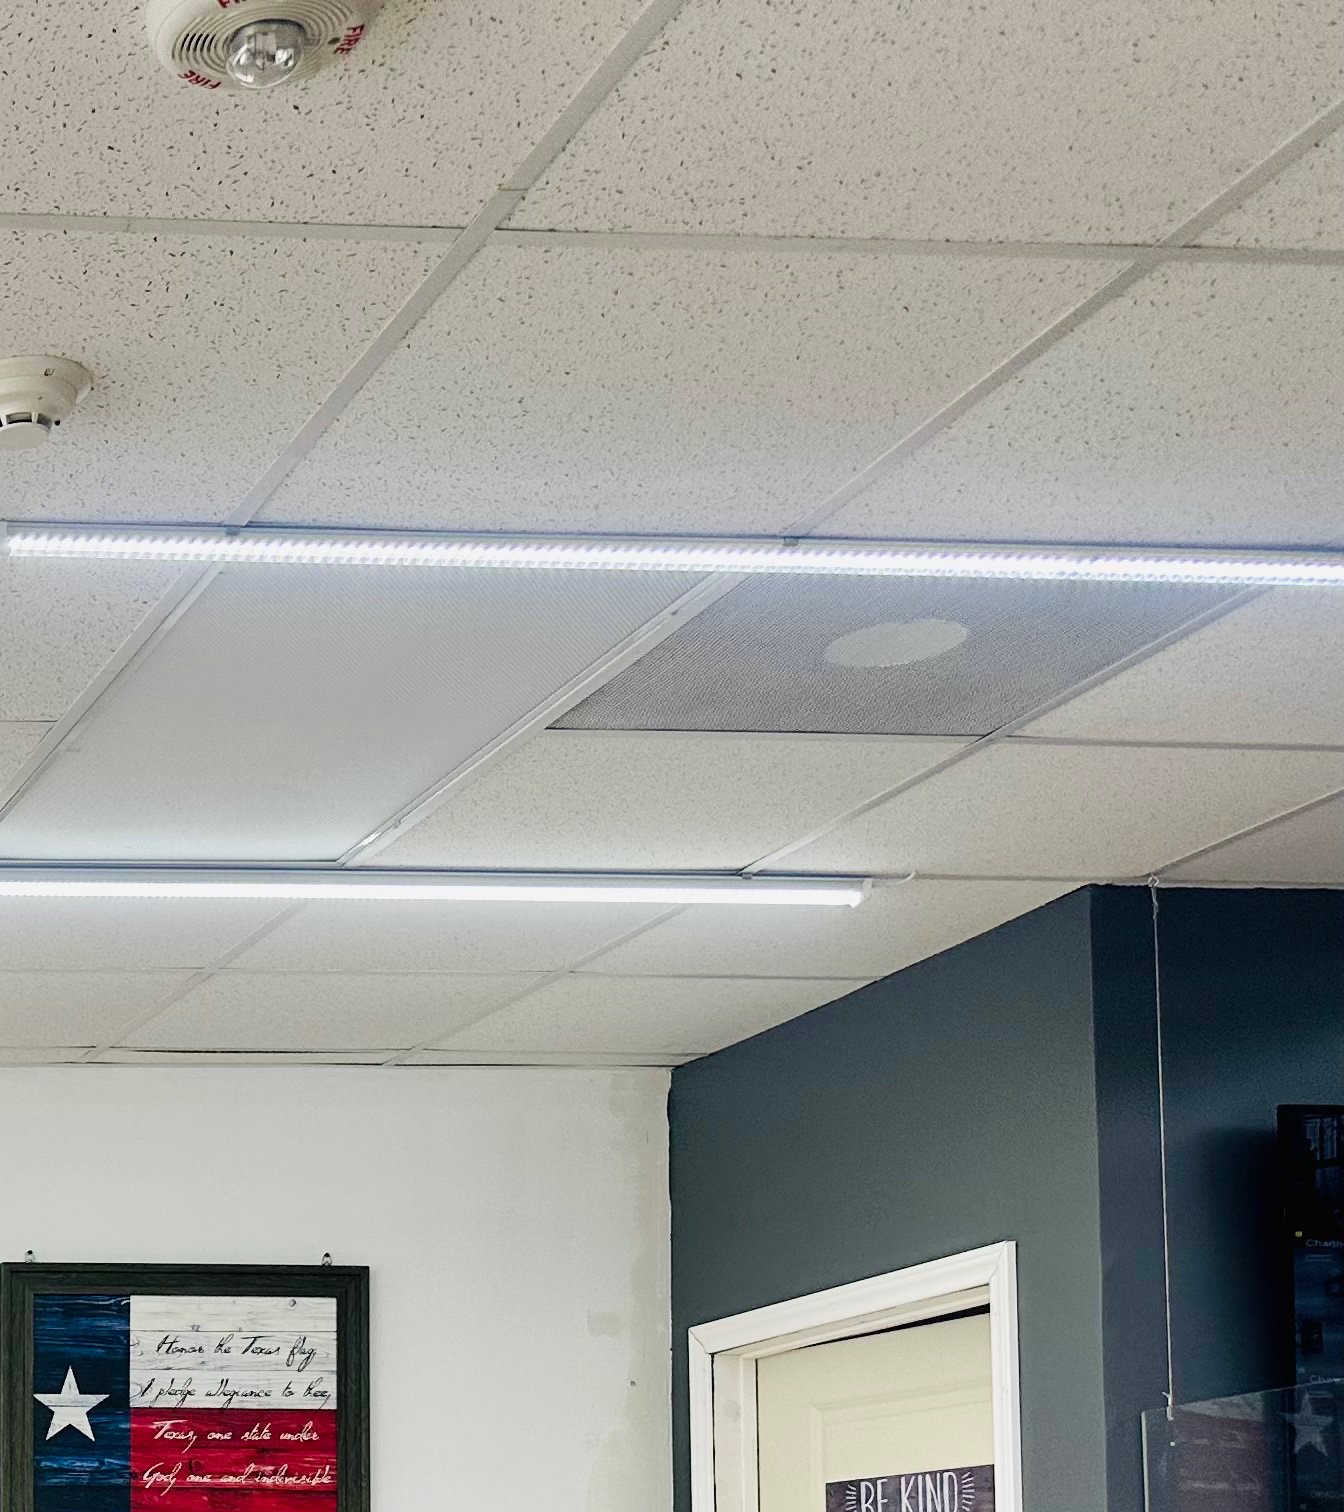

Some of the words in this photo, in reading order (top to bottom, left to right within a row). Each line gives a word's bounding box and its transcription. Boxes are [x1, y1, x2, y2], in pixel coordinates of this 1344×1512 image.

[333, 24, 365, 55] FIRE
[178, 69, 222, 89] FIRE
[213, 1333, 234, 1354] the
[241, 1335, 280, 1355] Texas
[282, 1380, 295, 1398] to
[207, 1431, 233, 1441] one
[241, 1422, 271, 1441] state
[220, 1463, 255, 1483] and
